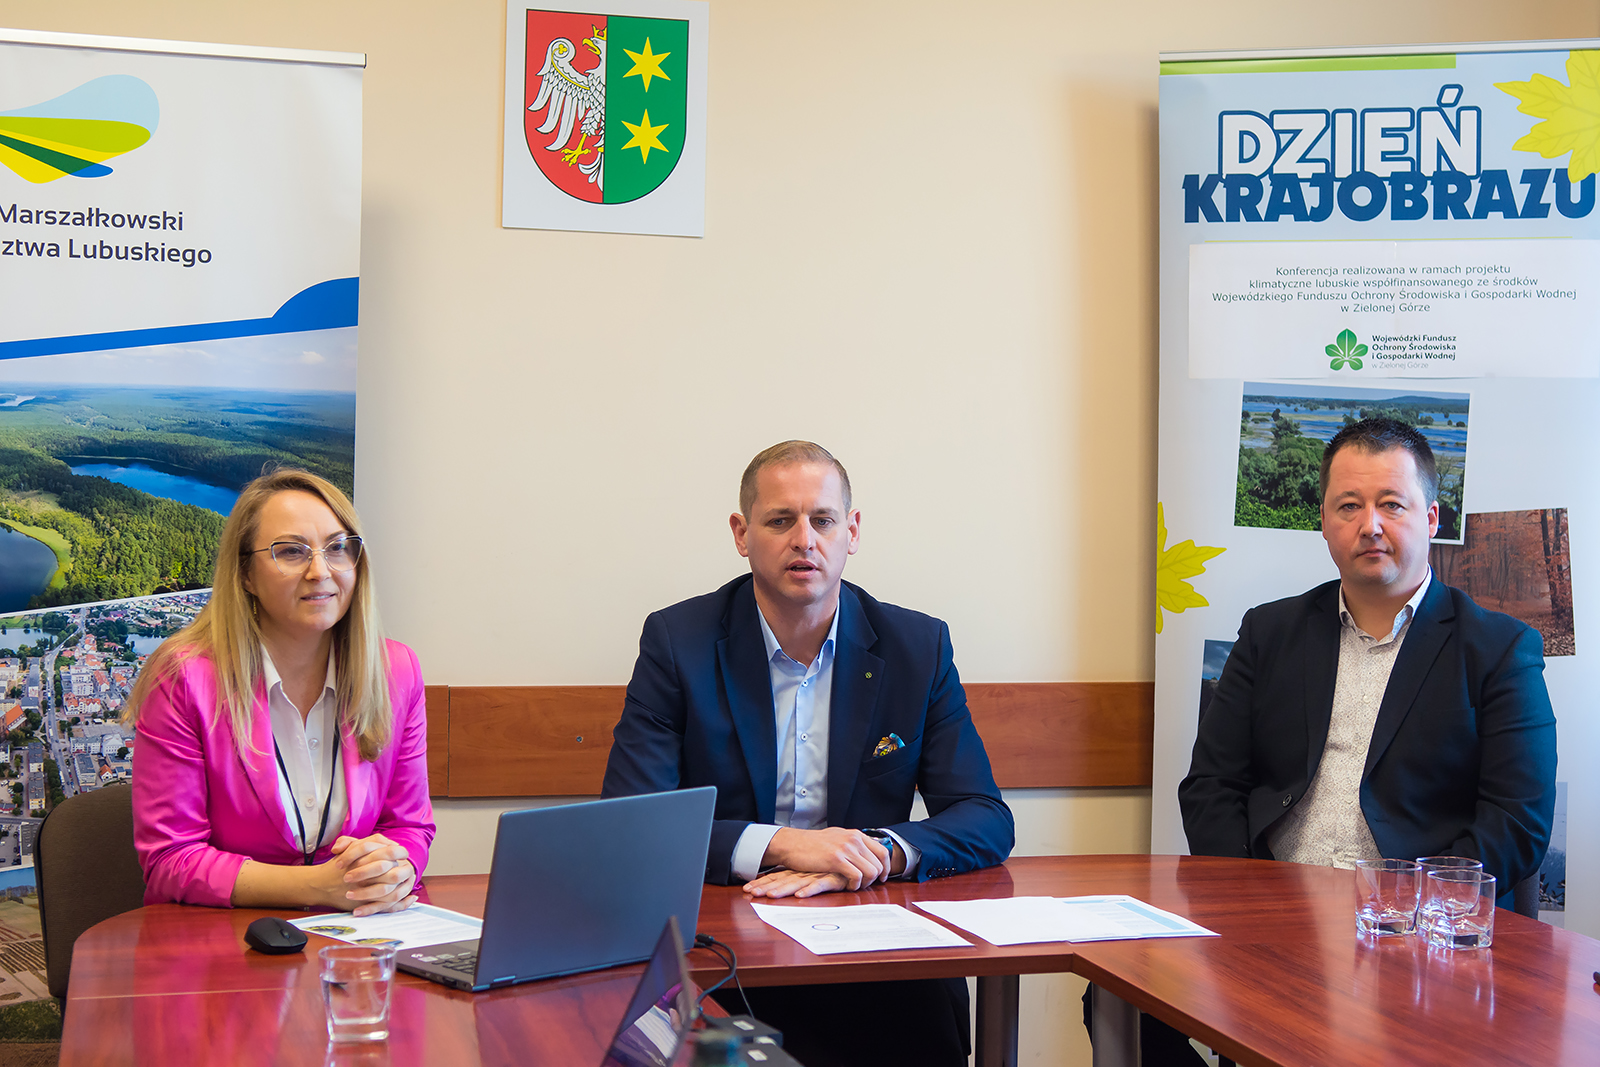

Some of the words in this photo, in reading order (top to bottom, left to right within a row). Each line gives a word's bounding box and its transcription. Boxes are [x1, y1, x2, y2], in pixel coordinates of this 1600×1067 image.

[1218, 84, 1482, 181] DZIEŃ
[1182, 168, 1597, 223] KRAJOBRAZU
[0, 203, 184, 231] Marszałkowski
[68, 238, 213, 268] Lubuskiego
[1275, 266, 1339, 277] Konferencja
[1342, 265, 1406, 276] realizowana
[1409, 266, 1418, 274] w
[1421, 264, 1462, 275] ramach
[1465, 264, 1511, 276] projektu
[1249, 279, 1312, 290] klimatyczne
[1315, 278, 1360, 288] lubuskie
[1362, 277, 1474, 289] współfinansowanego
[1477, 278, 1489, 287] ze
[1492, 276, 1539, 287] środków
[1212, 292, 1294, 304] Wojewódzkiego
[1297, 291, 1348, 301] Funduszu
[1351, 290, 1396, 302] Ochrony
[1399, 288, 1461, 300] Środowiska
[1471, 289, 1532, 301] Gospodarki
[1536, 289, 1577, 300] Wodnej
[1340, 305, 1349, 313] w
[1353, 303, 1396, 315] Zielonej
[1399, 302, 1431, 313] Górze
[1372, 334, 1421, 344] Wojewódzki
[1423, 334, 1457, 342] Fundusz
[1372, 343, 1407, 352] Ochrony
[1408, 342, 1456, 351] Środowiska
[1376, 352, 1423, 361] Gospodarki
[1424, 352, 1456, 361] Wodnej
[1379, 361, 1407, 370] Zielonej
[1407, 361, 1429, 369] Górze
